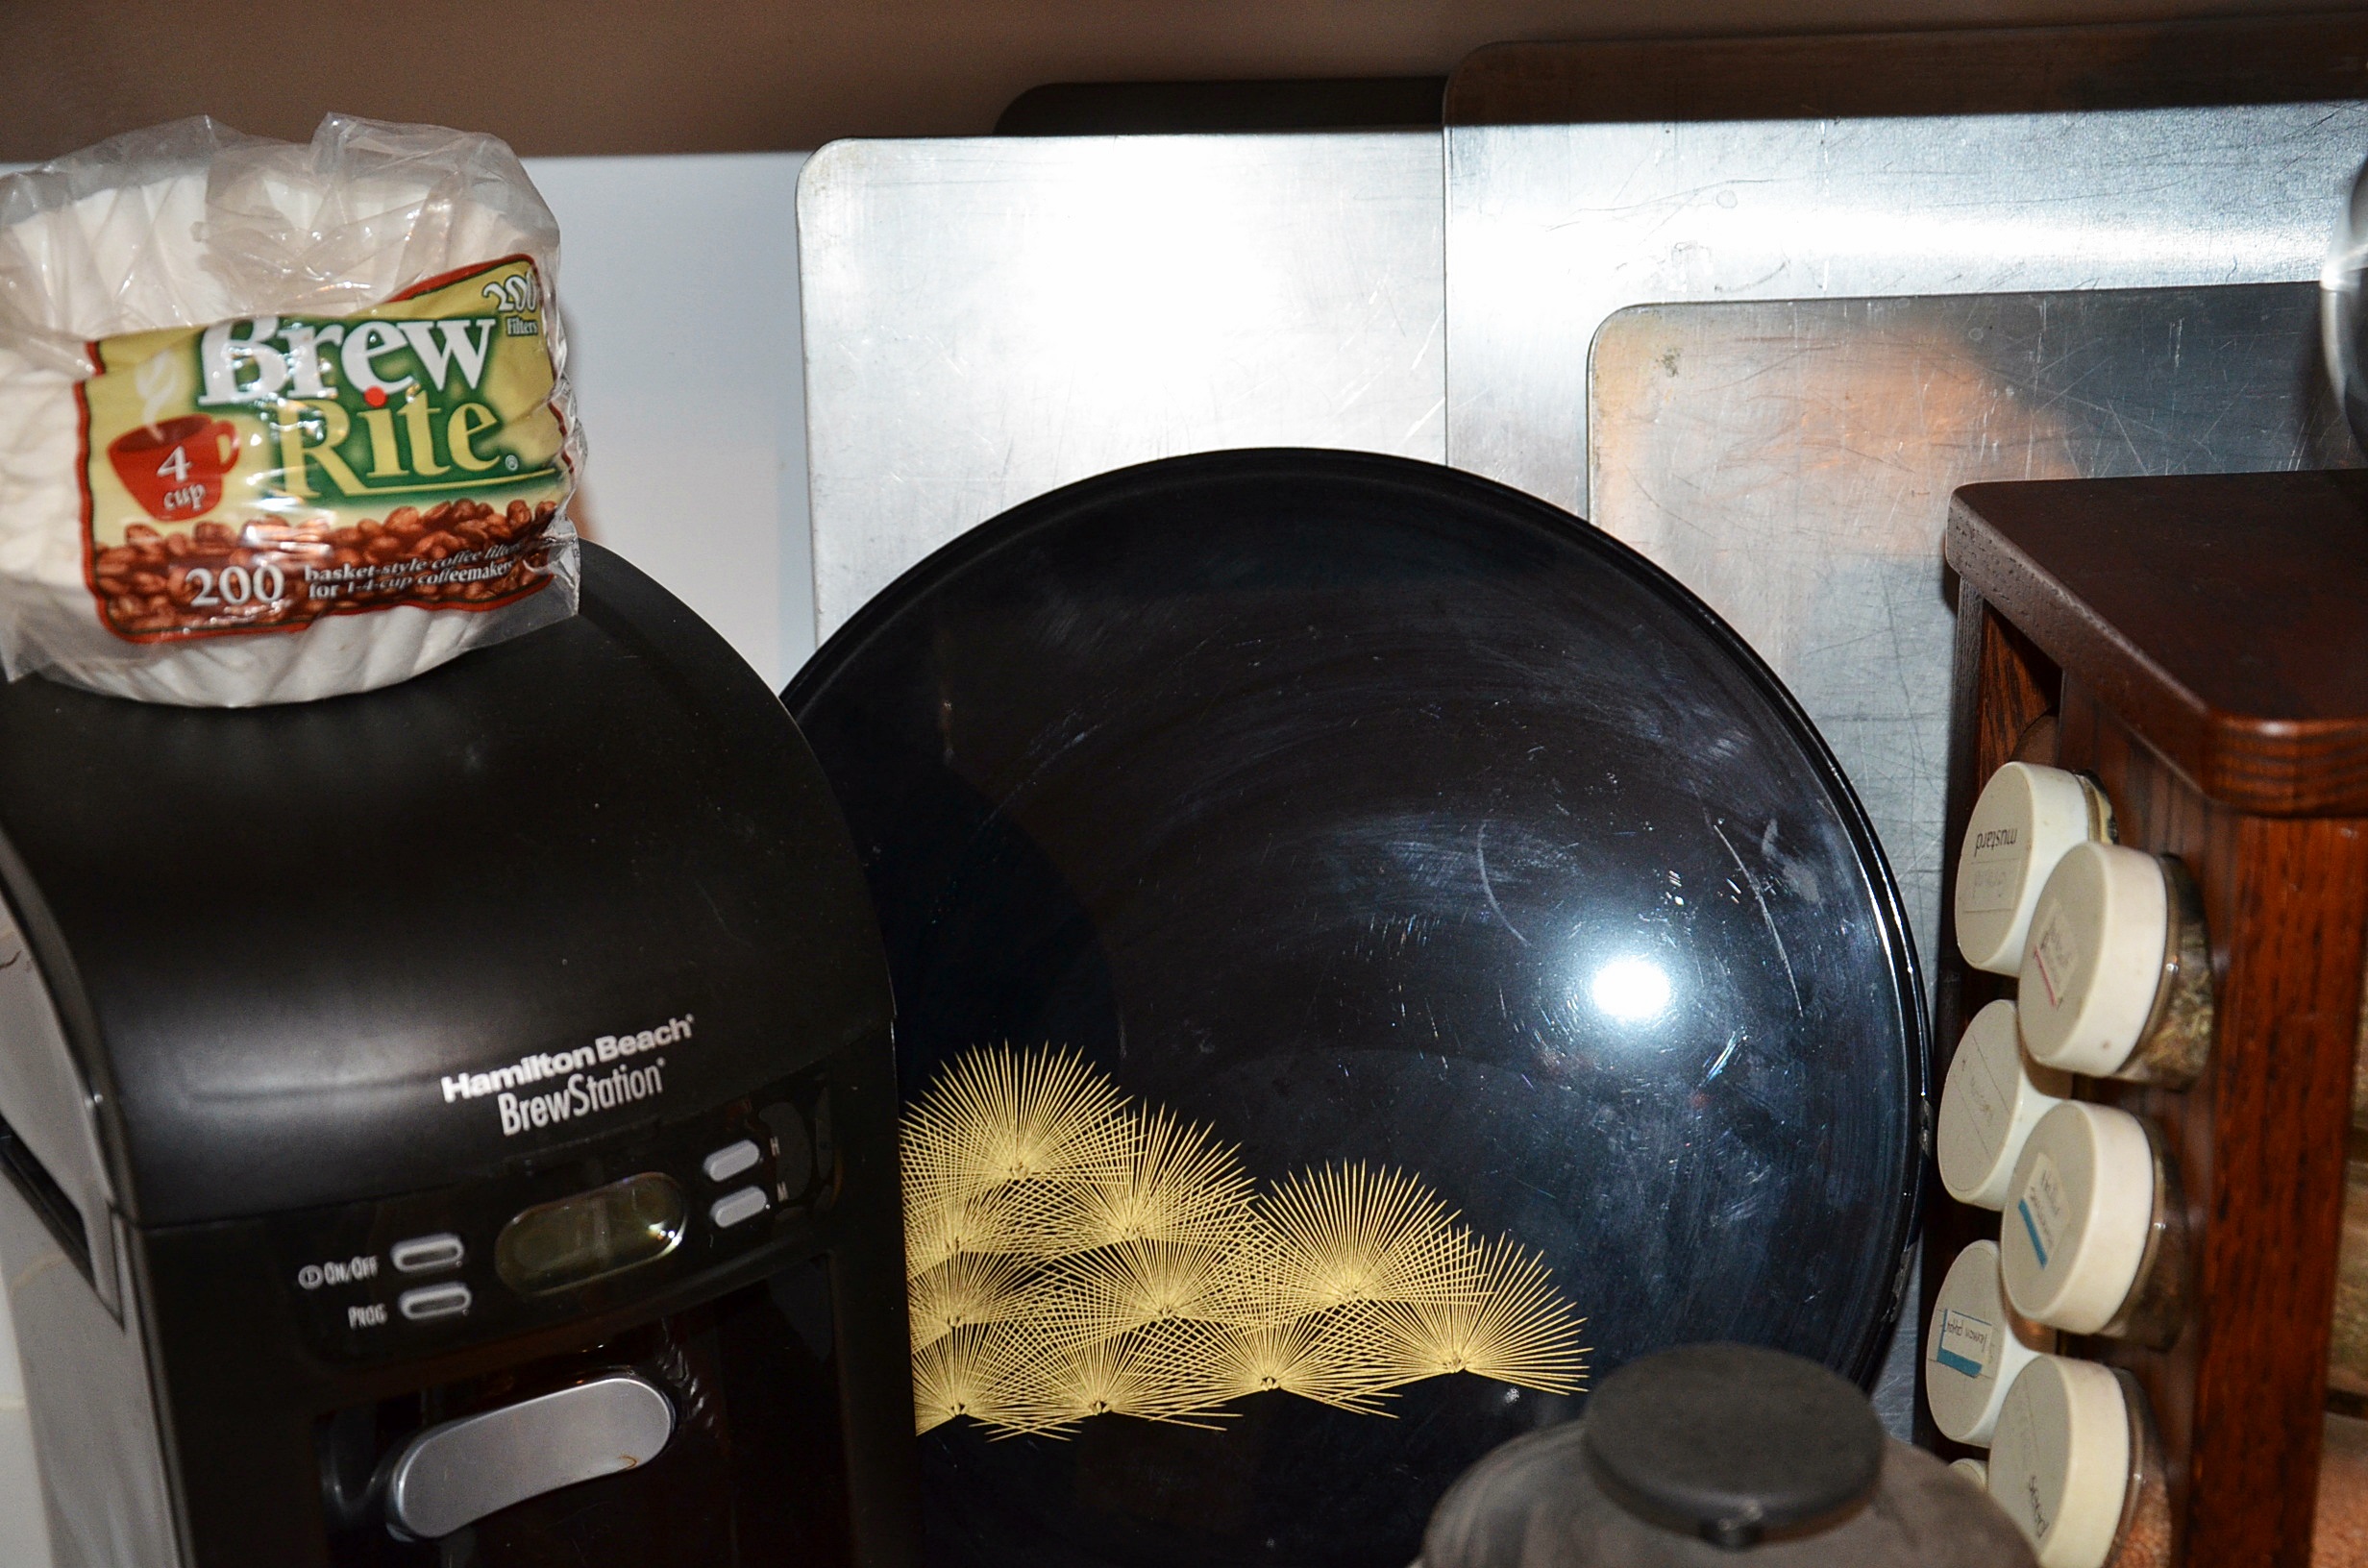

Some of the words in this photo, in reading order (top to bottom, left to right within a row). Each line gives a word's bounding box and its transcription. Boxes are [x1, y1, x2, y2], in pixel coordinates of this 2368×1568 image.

[481, 270, 537, 312] 200
[506, 316, 539, 337] Filters
[198, 316, 496, 406] Brew
[275, 386, 501, 498] Rite
[157, 445, 191, 481] 4
[163, 481, 207, 512] cup
[304, 556, 429, 582] basket-style
[431, 548, 481, 569] coffee
[189, 565, 285, 607] 200
[308, 581, 339, 600] for
[347, 576, 412, 594] 1-4-cup
[1974, 827, 2017, 857] mustard
[440, 1044, 597, 1104] Hamilton
[595, 1016, 694, 1064] Beach
[497, 1063, 664, 1138] BrewStation
